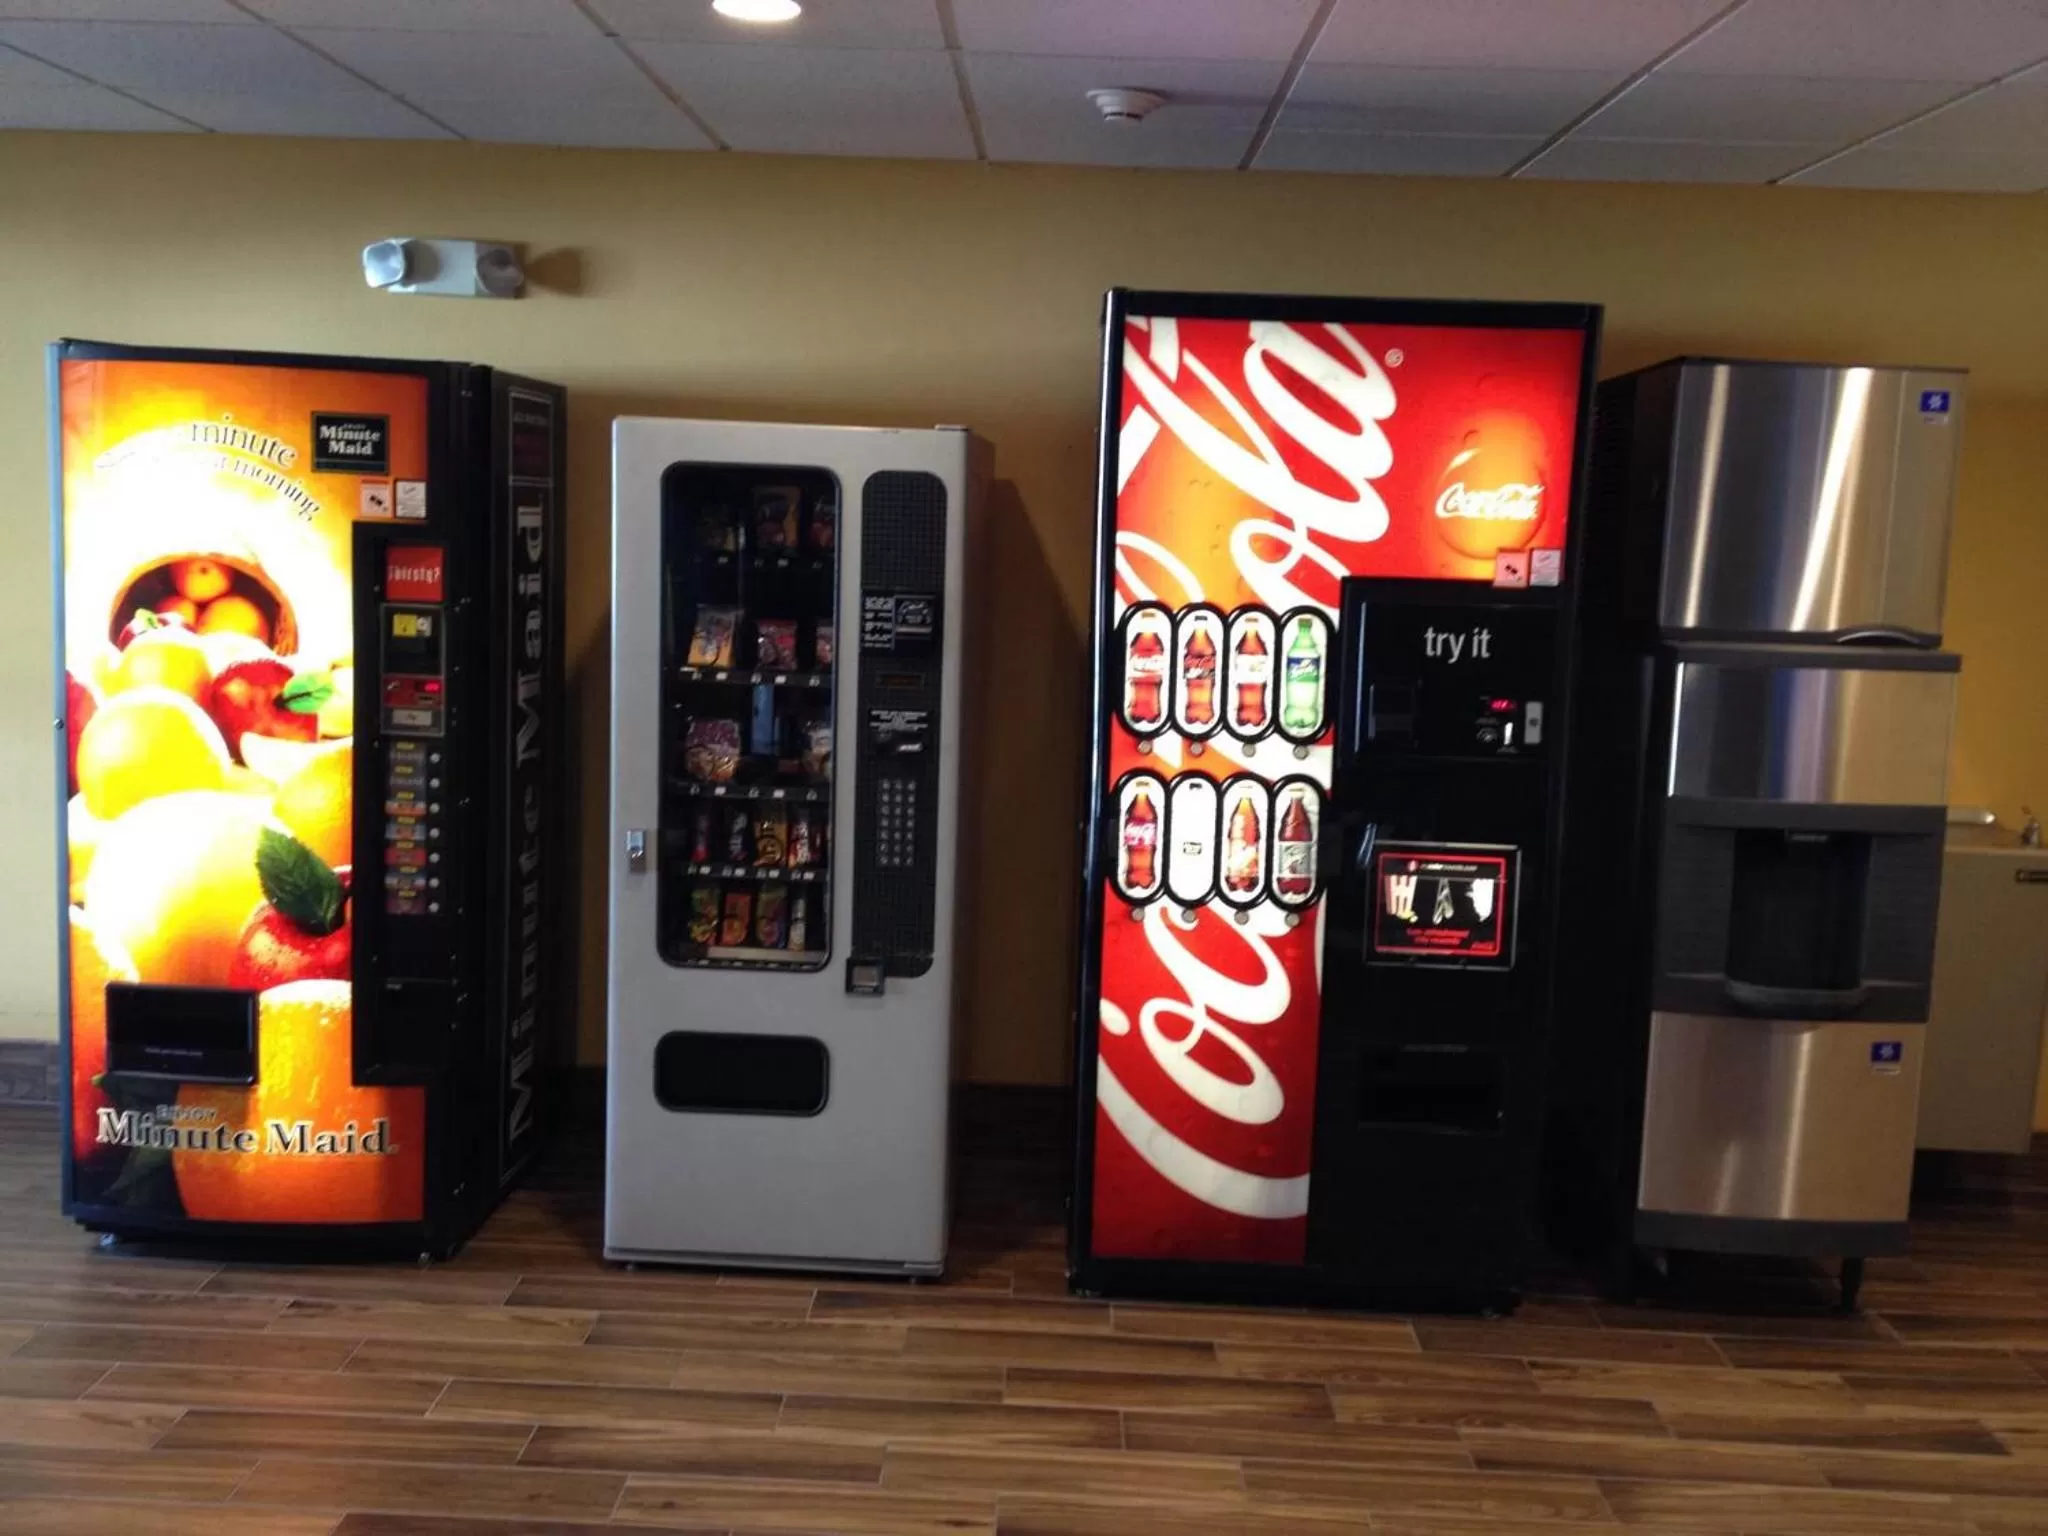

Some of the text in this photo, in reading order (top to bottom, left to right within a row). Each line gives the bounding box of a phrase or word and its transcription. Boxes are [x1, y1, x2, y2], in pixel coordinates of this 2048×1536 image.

[190, 414, 296, 468] minute
[319, 424, 381, 442] Minute
[328, 440, 373, 455] Maid
[515, 504, 544, 770] Maid
[1424, 626, 1492, 664] try it
[96, 1107, 257, 1154] Minute
